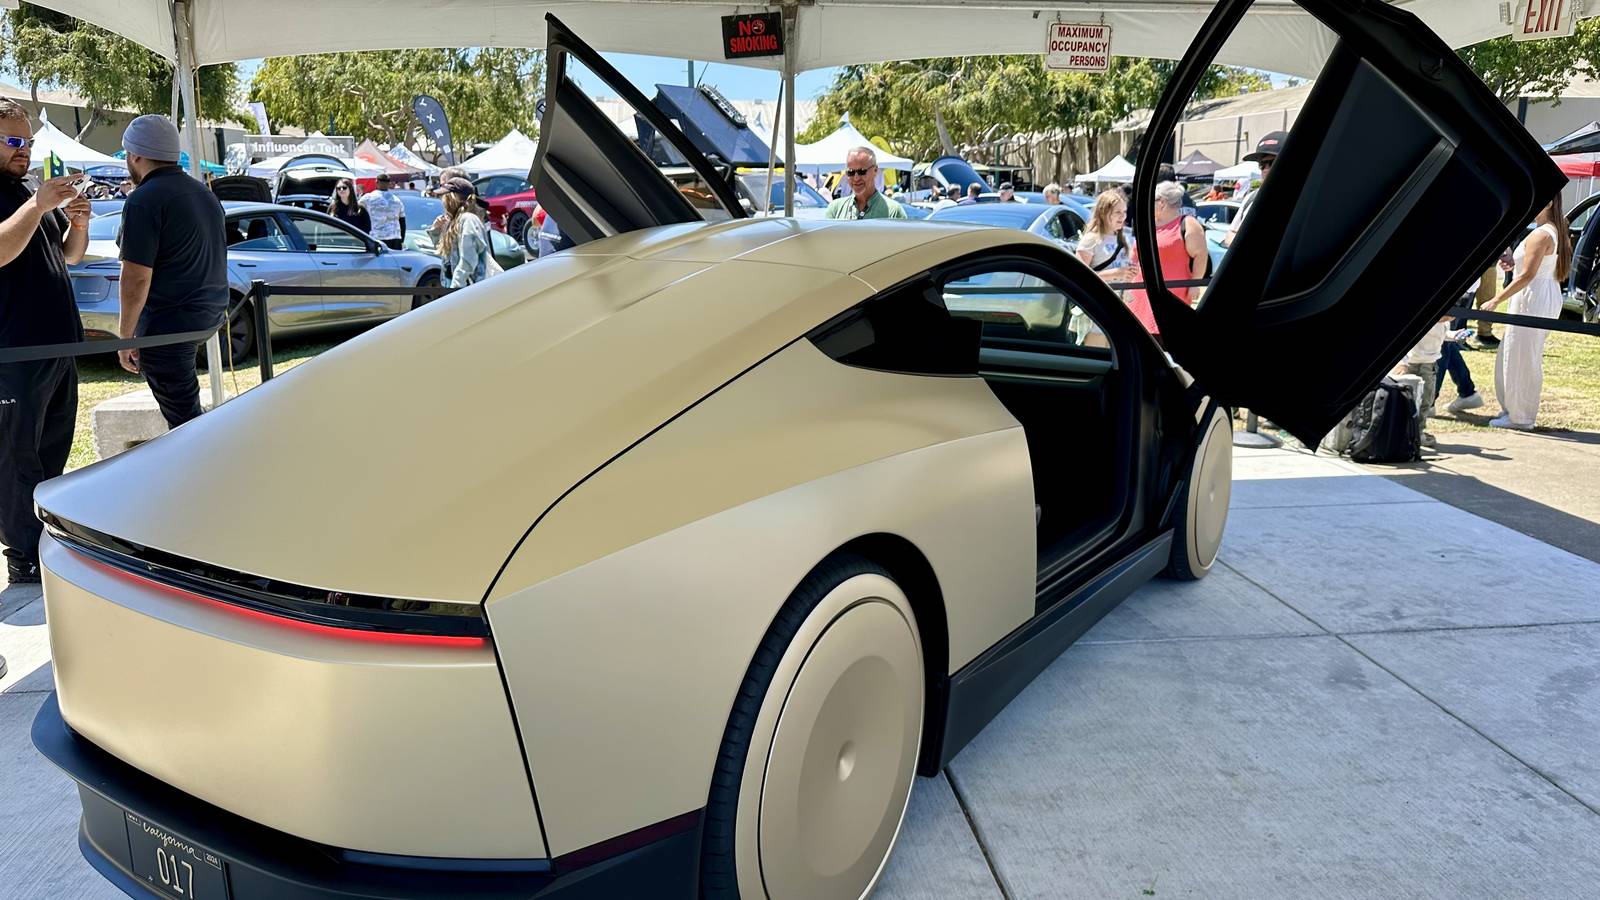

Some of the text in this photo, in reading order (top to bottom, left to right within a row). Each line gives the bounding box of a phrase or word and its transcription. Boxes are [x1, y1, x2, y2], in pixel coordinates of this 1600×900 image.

[1057, 26, 1104, 39] MAXIMUM
[730, 34, 778, 53] SMOKING
[1051, 40, 1108, 53] OCCUPANCY
[1069, 55, 1106, 67] PERSONS
[254, 142, 345, 153] Influencer Tent
[157, 847, 193, 900] 017
